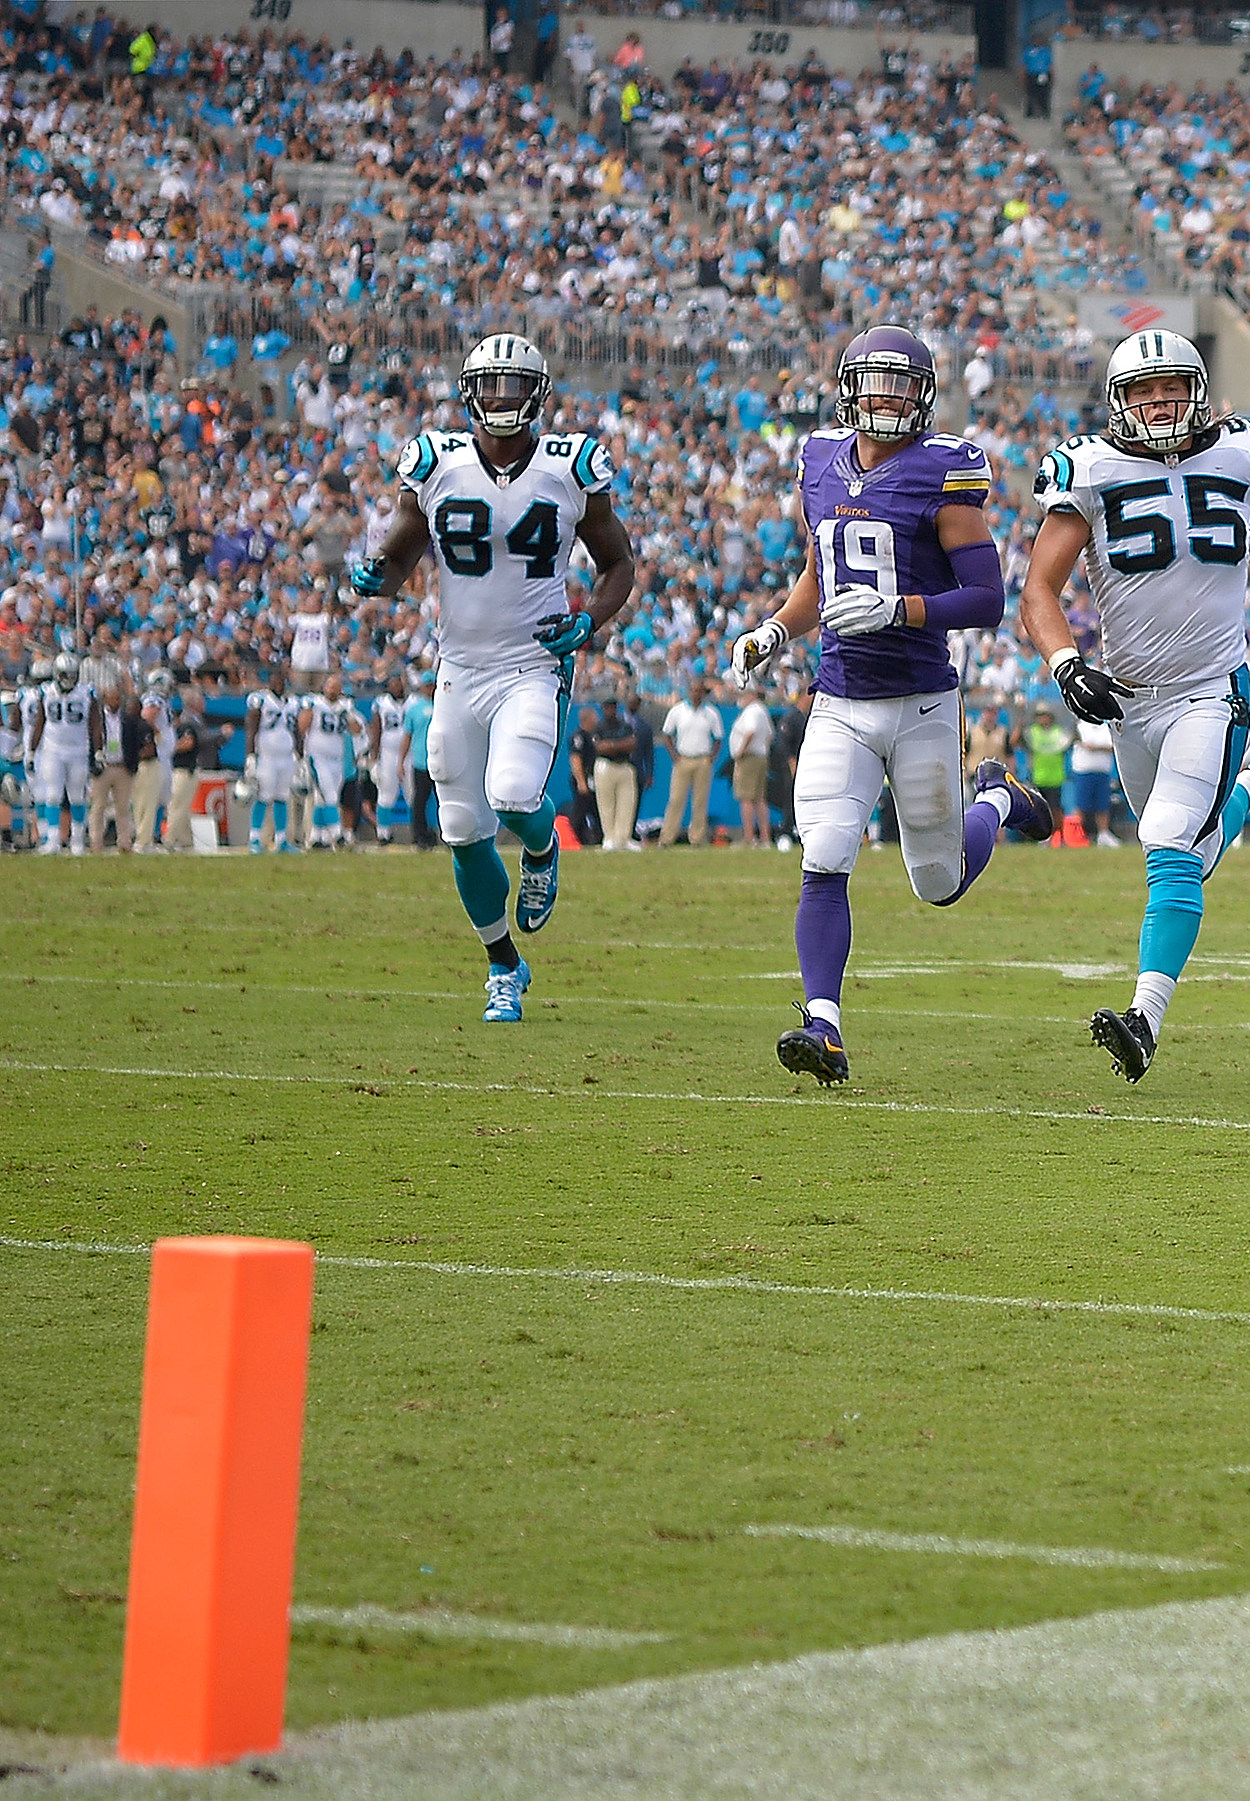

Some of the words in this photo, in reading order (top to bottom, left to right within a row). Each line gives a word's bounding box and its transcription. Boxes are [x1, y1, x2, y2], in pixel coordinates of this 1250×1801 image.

[434, 496, 561, 579] 84
[814, 519, 899, 602] 19
[1100, 472, 1250, 576] 55
[49, 701, 85, 723] 95
